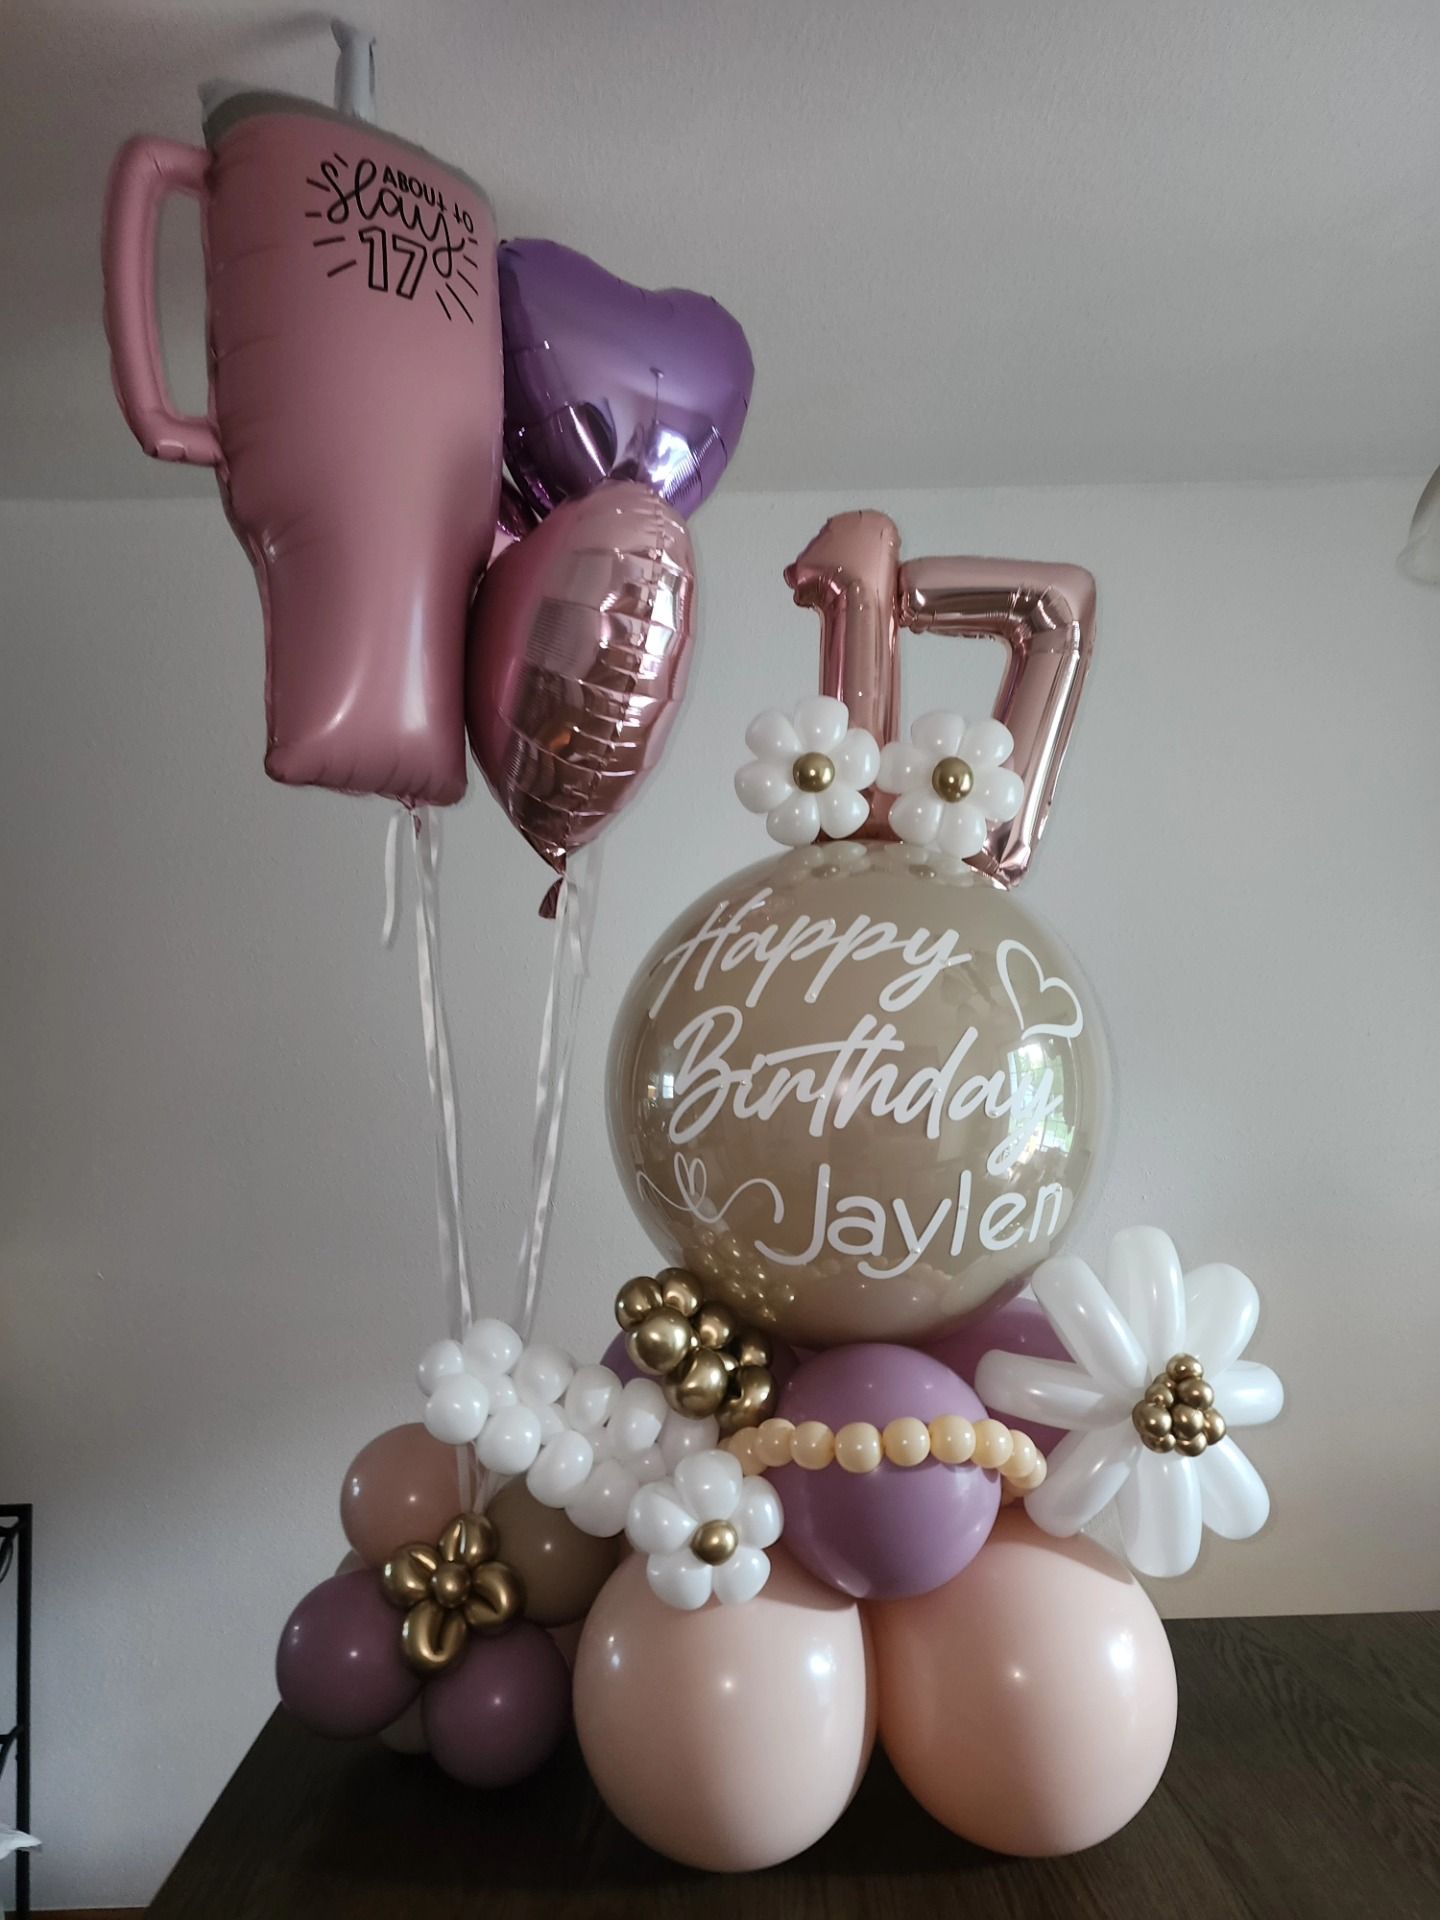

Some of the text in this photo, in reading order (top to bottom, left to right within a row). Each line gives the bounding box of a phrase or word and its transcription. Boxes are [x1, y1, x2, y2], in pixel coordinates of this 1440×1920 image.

[358, 225, 428, 300] 17
[783, 509, 1097, 890] 17
[649, 887, 972, 1012] Happy
[669, 1005, 1064, 1176] Birthday
[754, 1163, 1063, 1278] Jaylen
